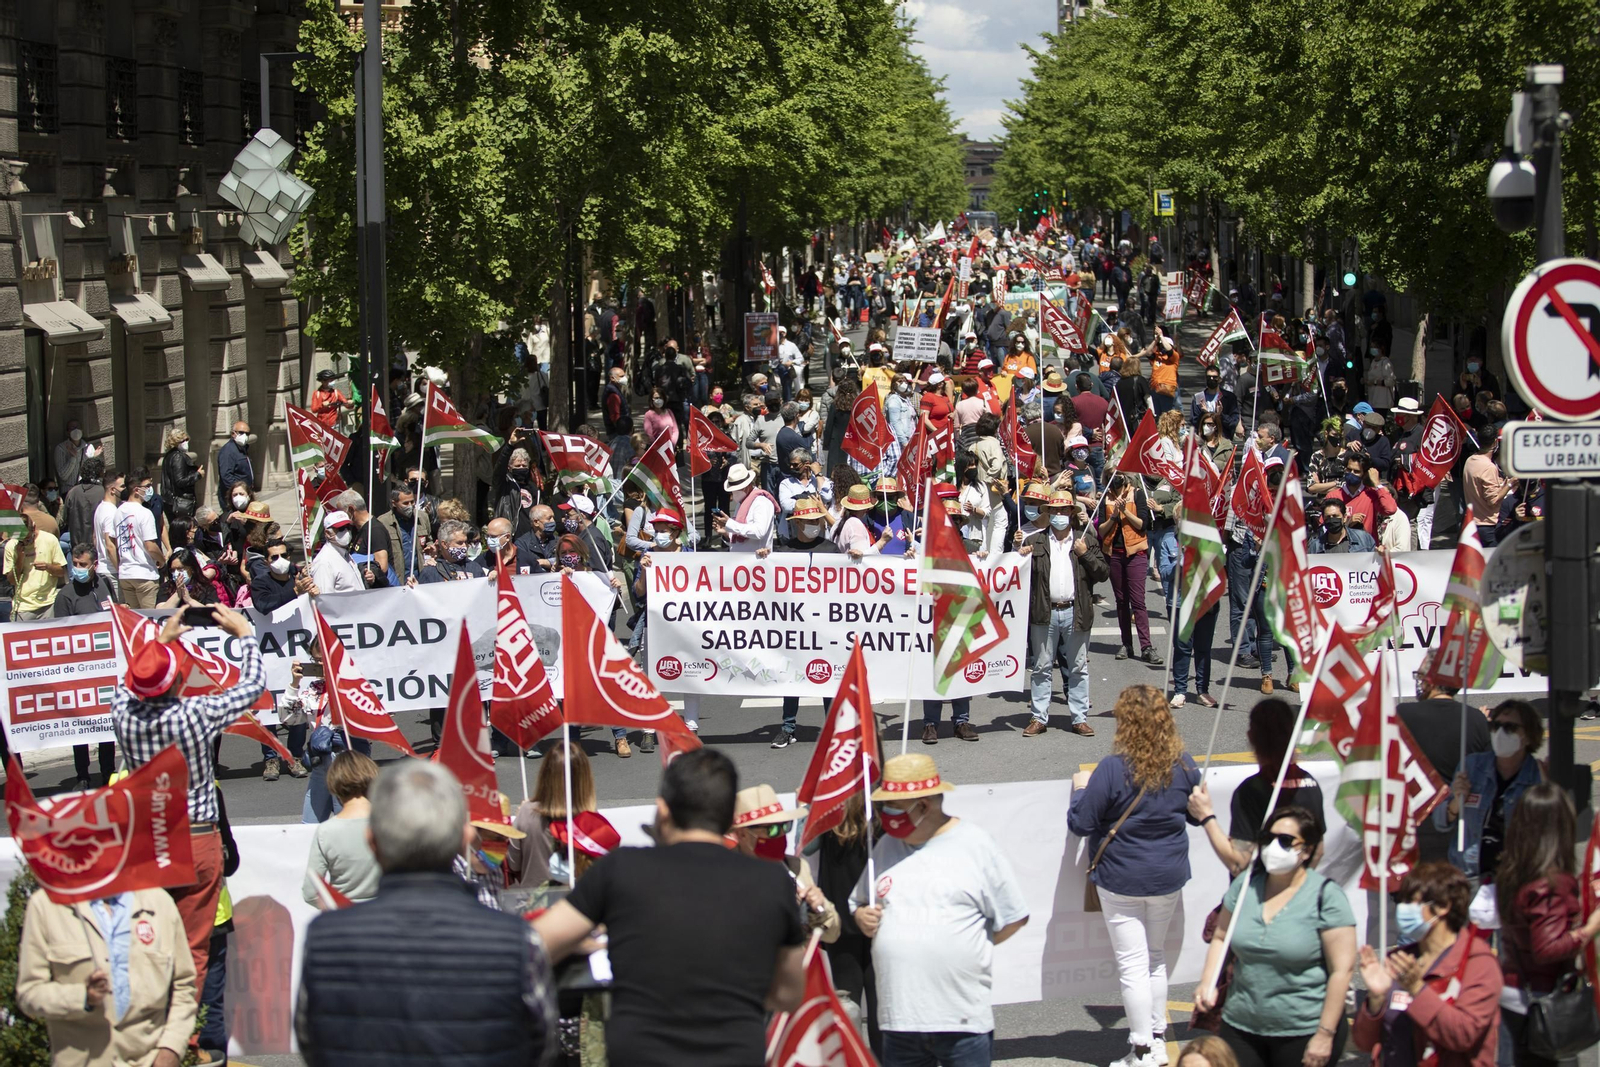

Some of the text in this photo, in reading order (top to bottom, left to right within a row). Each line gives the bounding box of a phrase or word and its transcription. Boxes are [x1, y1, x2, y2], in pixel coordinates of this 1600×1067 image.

[1523, 434, 1592, 447] EXCEPTO
[1545, 453, 1600, 467] URBAN
[656, 565, 690, 594] NO
[695, 565, 712, 592] A
[719, 565, 766, 593] LOS
[774, 565, 895, 595] DESPIDOS
[977, 566, 1021, 595] NCA
[1348, 571, 1378, 584] FICA
[663, 601, 805, 623] CAIXABANK
[829, 603, 893, 624] BBVA
[701, 629, 823, 651] SABADELL
[6, 661, 117, 681] Universidad de Granada
[684, 661, 710, 670] FeSMC
[11, 722, 51, 735] servicios
[61, 719, 70, 728] la
[71, 716, 114, 728] ciudadan
[39, 724, 115, 740] granada andaluc
